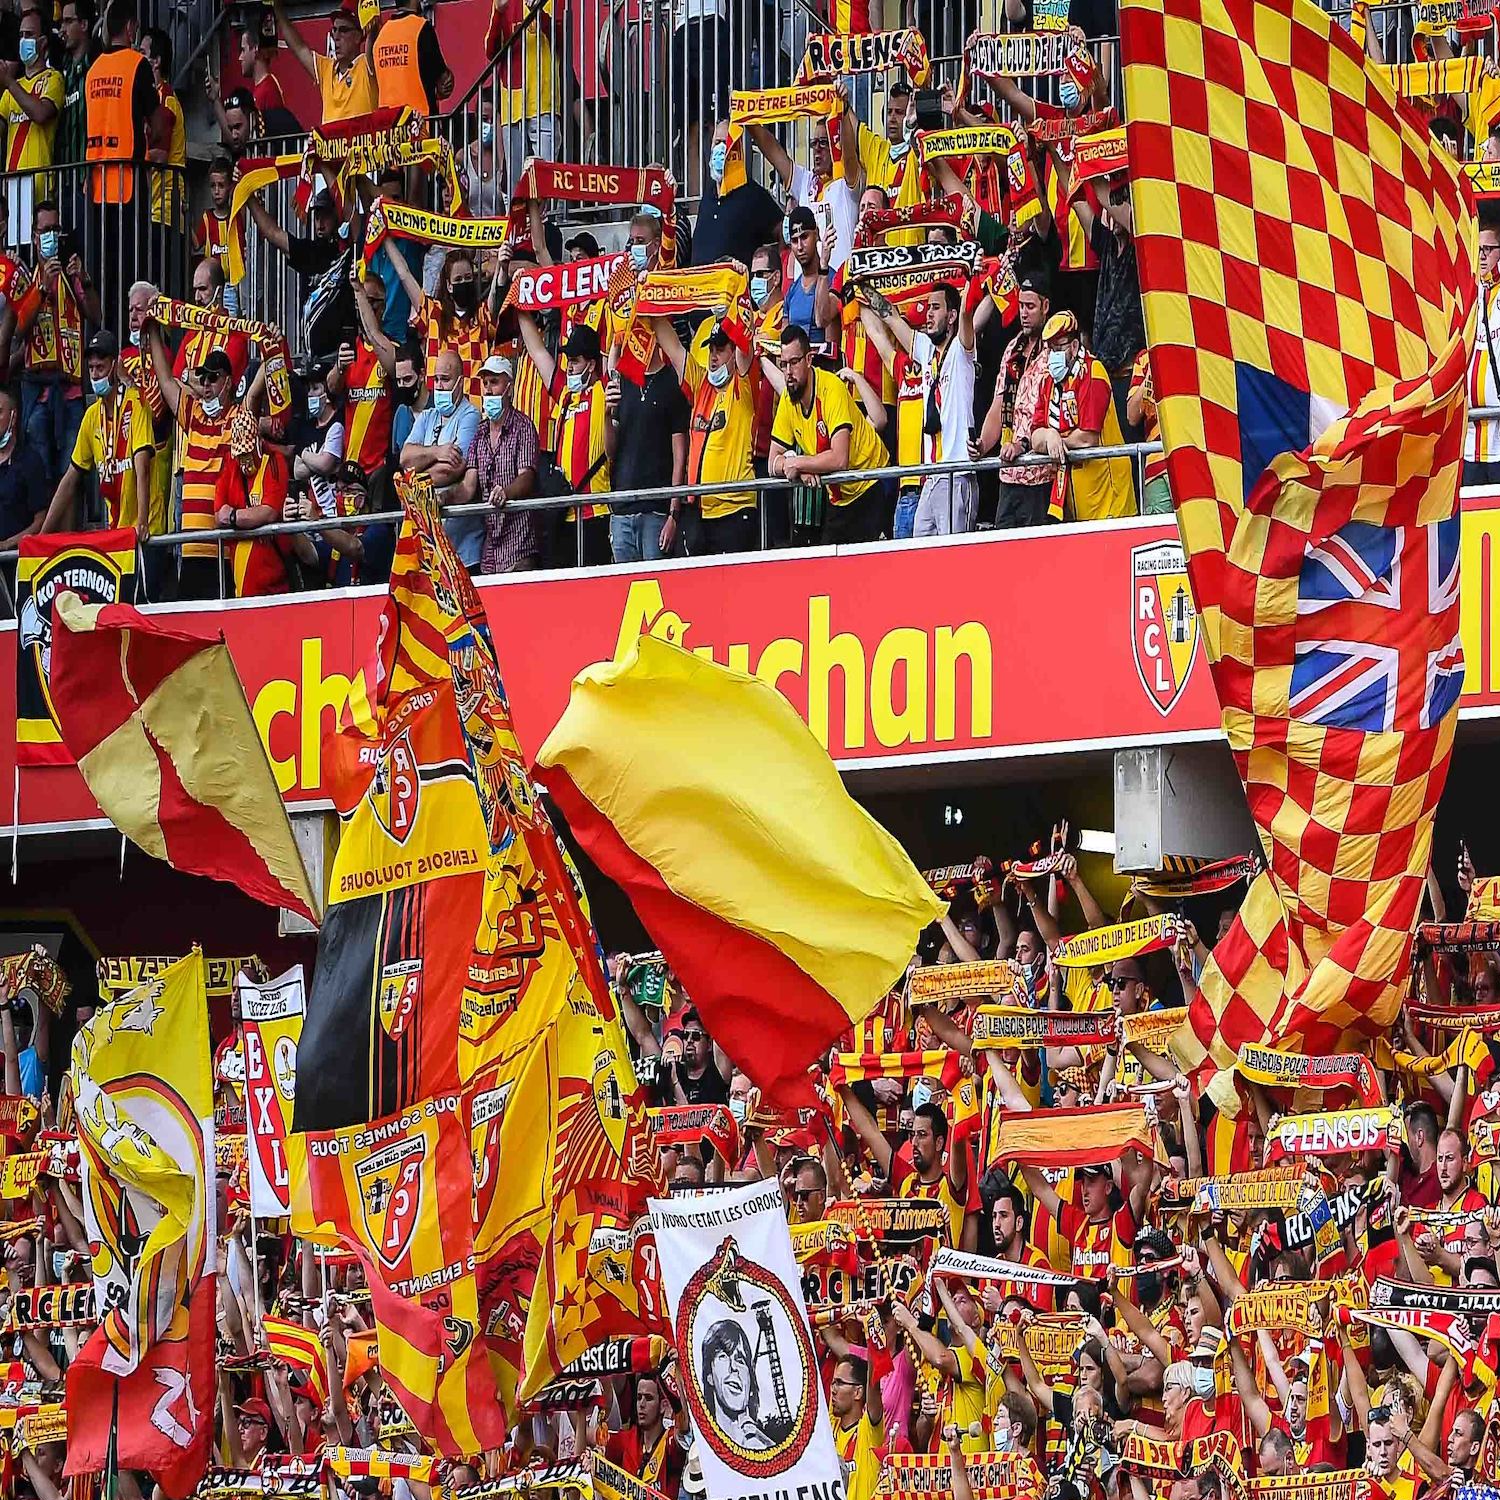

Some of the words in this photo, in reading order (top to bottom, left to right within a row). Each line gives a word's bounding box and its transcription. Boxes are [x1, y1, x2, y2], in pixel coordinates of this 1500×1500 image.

[790, 90, 837, 109] LENSOI
[926, 137, 956, 157] RACING
[958, 134, 980, 153] CLUB
[553, 170, 574, 191] RC
[578, 173, 620, 195] LENS
[388, 209, 428, 231] RACING
[429, 214, 458, 236] CLUB
[459, 221, 474, 239] DE
[475, 224, 504, 242] LENS
[853, 246, 908, 272] LENS
[519, 275, 553, 304] RC
[559, 256, 624, 298] LENS
[1137, 560, 1157, 572] RACING
[64, 570, 116, 600] TERNOIS
[609, 579, 992, 750] Achan
[1069, 937, 1099, 958] RACING
[1100, 931, 1123, 952] CLUB
[1124, 927, 1136, 945] DE
[1138, 921, 1159, 942] LENS
[1244, 1048, 1282, 1073] LENSOIS
[1283, 1055, 1310, 1076] POUR
[1312, 1056, 1359, 1075] TOUJOURS
[1300, 1115, 1379, 1149] LENSOIS
[661, 1210, 688, 1230] NORD
[724, 1203, 742, 1222] LES
[743, 1188, 782, 1218] CORONS
[1286, 1212, 1312, 1249] RC
[1328, 1186, 1362, 1223] ENS
